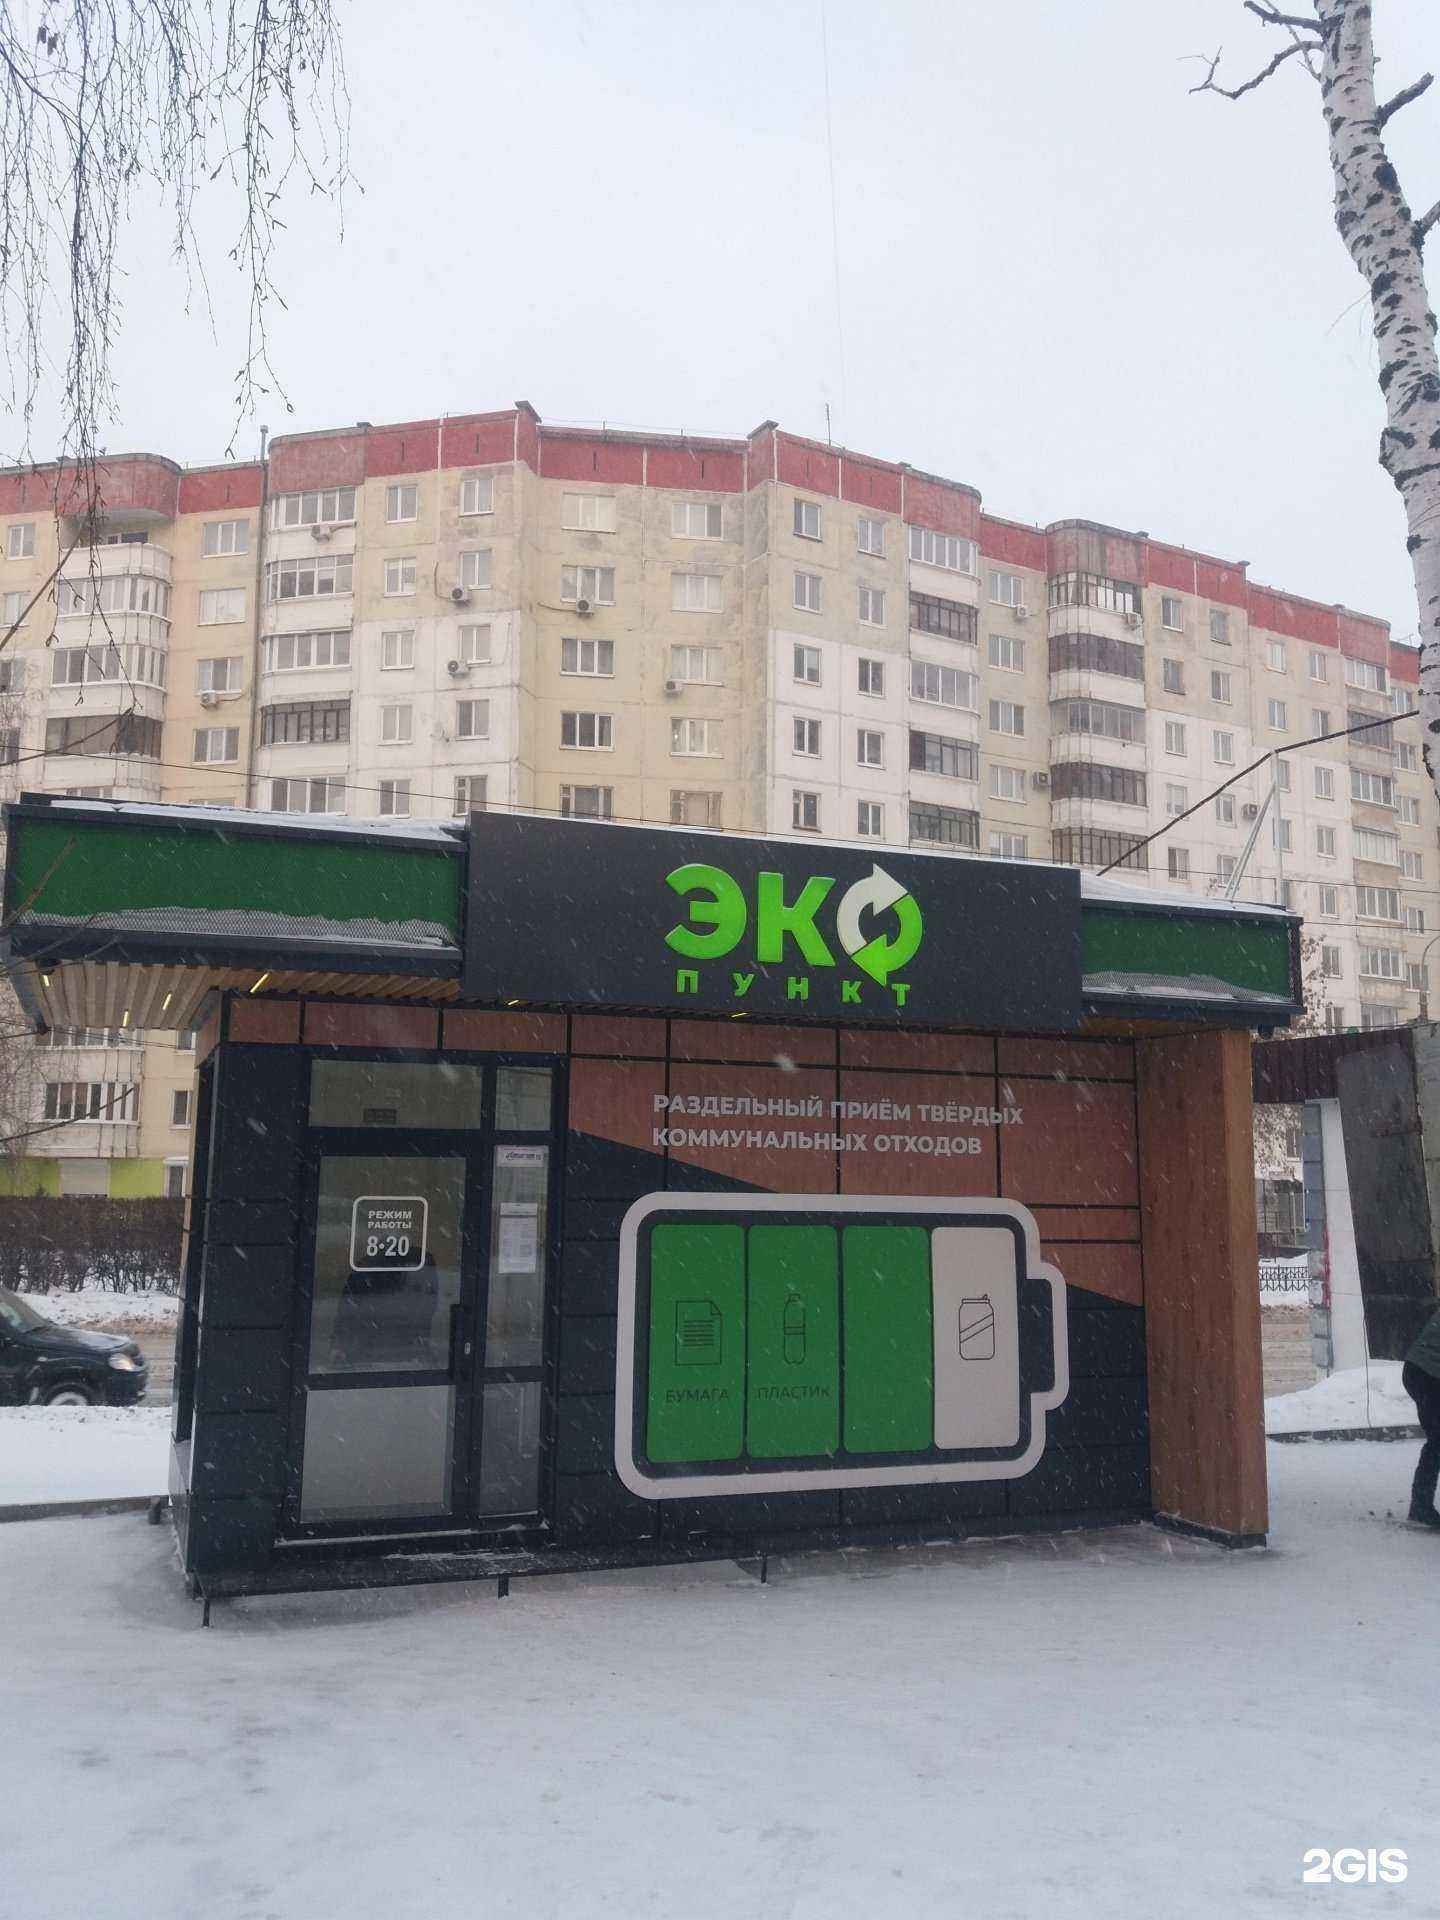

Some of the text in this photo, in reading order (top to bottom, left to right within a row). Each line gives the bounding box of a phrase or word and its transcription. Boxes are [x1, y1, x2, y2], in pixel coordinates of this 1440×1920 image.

[676, 969, 911, 1006] ПУНКТ
[652, 1094, 1024, 1126] РАЗДЕЛЬНЫЙ ПРИЁМ ТВЁРДЫХ
[652, 1127, 982, 1155] КОММУНАЛЬНЫХ ОТХОДОВ
[367, 1210, 412, 1219] РЕЖИМ
[367, 1221, 412, 1229] РАБОТЫ
[665, 1387, 729, 1403] БУМАГА
[757, 1384, 831, 1401] ПЛАСТИК
